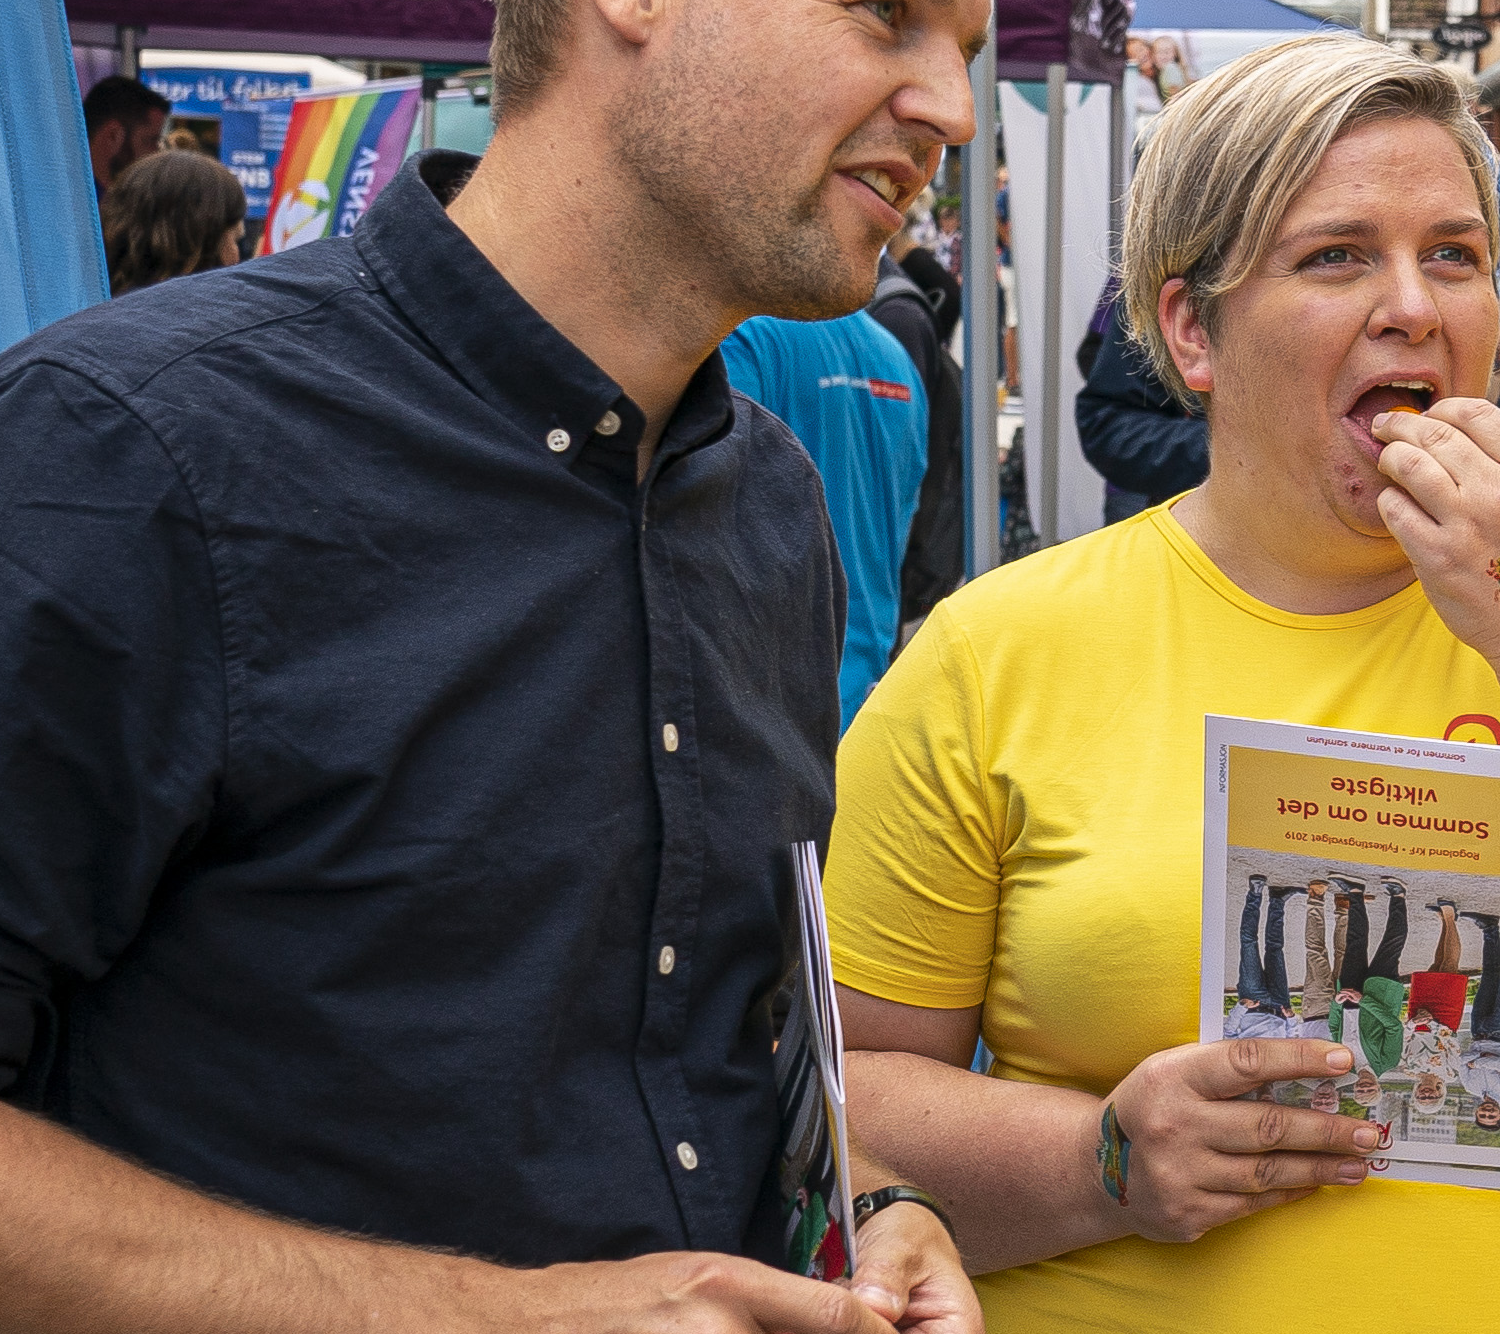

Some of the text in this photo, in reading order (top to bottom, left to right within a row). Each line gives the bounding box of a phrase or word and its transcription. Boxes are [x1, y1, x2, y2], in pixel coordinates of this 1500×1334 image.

[1306, 735, 1466, 763] Sammen for et varmere samfunn
[1330, 776, 1438, 805] viktigste
[1276, 796, 1489, 839] Sammen om det
[1285, 830, 1481, 861] Rogaland KrF Fylkestingsvalget 2019
